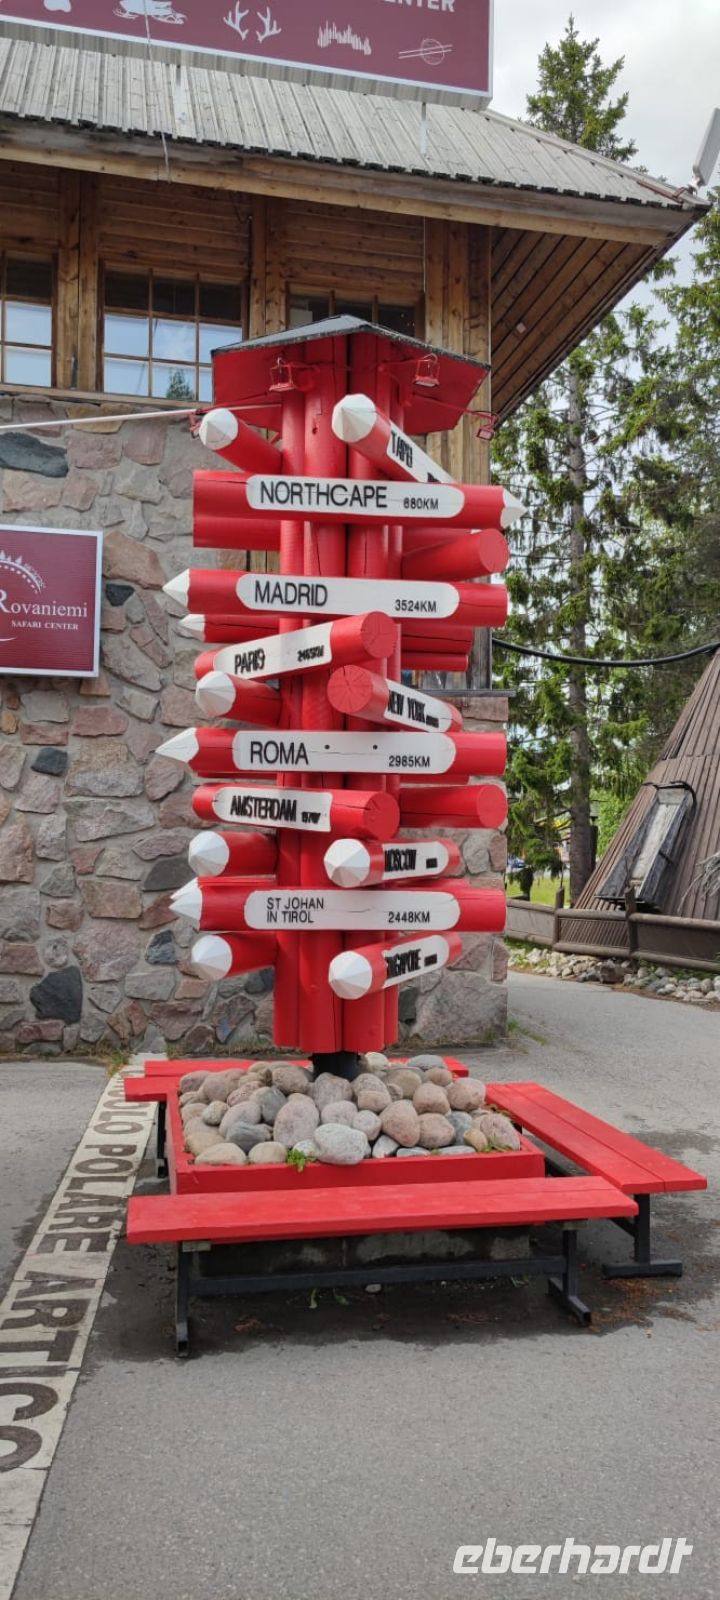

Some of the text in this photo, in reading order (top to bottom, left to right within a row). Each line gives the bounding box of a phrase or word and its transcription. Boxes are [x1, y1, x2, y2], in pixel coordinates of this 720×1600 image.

[260, 481, 388, 508] NORTHCAPE
[254, 580, 437, 613] MADRID 3524KM
[11, 620, 79, 630] SAFARI CENTER
[234, 648, 266, 674] PARIS
[249, 741, 431, 768] ROMA 2985KM
[230, 795, 298, 822] AMSTERDAM
[266, 898, 324, 910] ST JOHAN
[266, 911, 431, 924] IN TIROL 2448KM
[36, 1144, 137, 1254] POLARE
